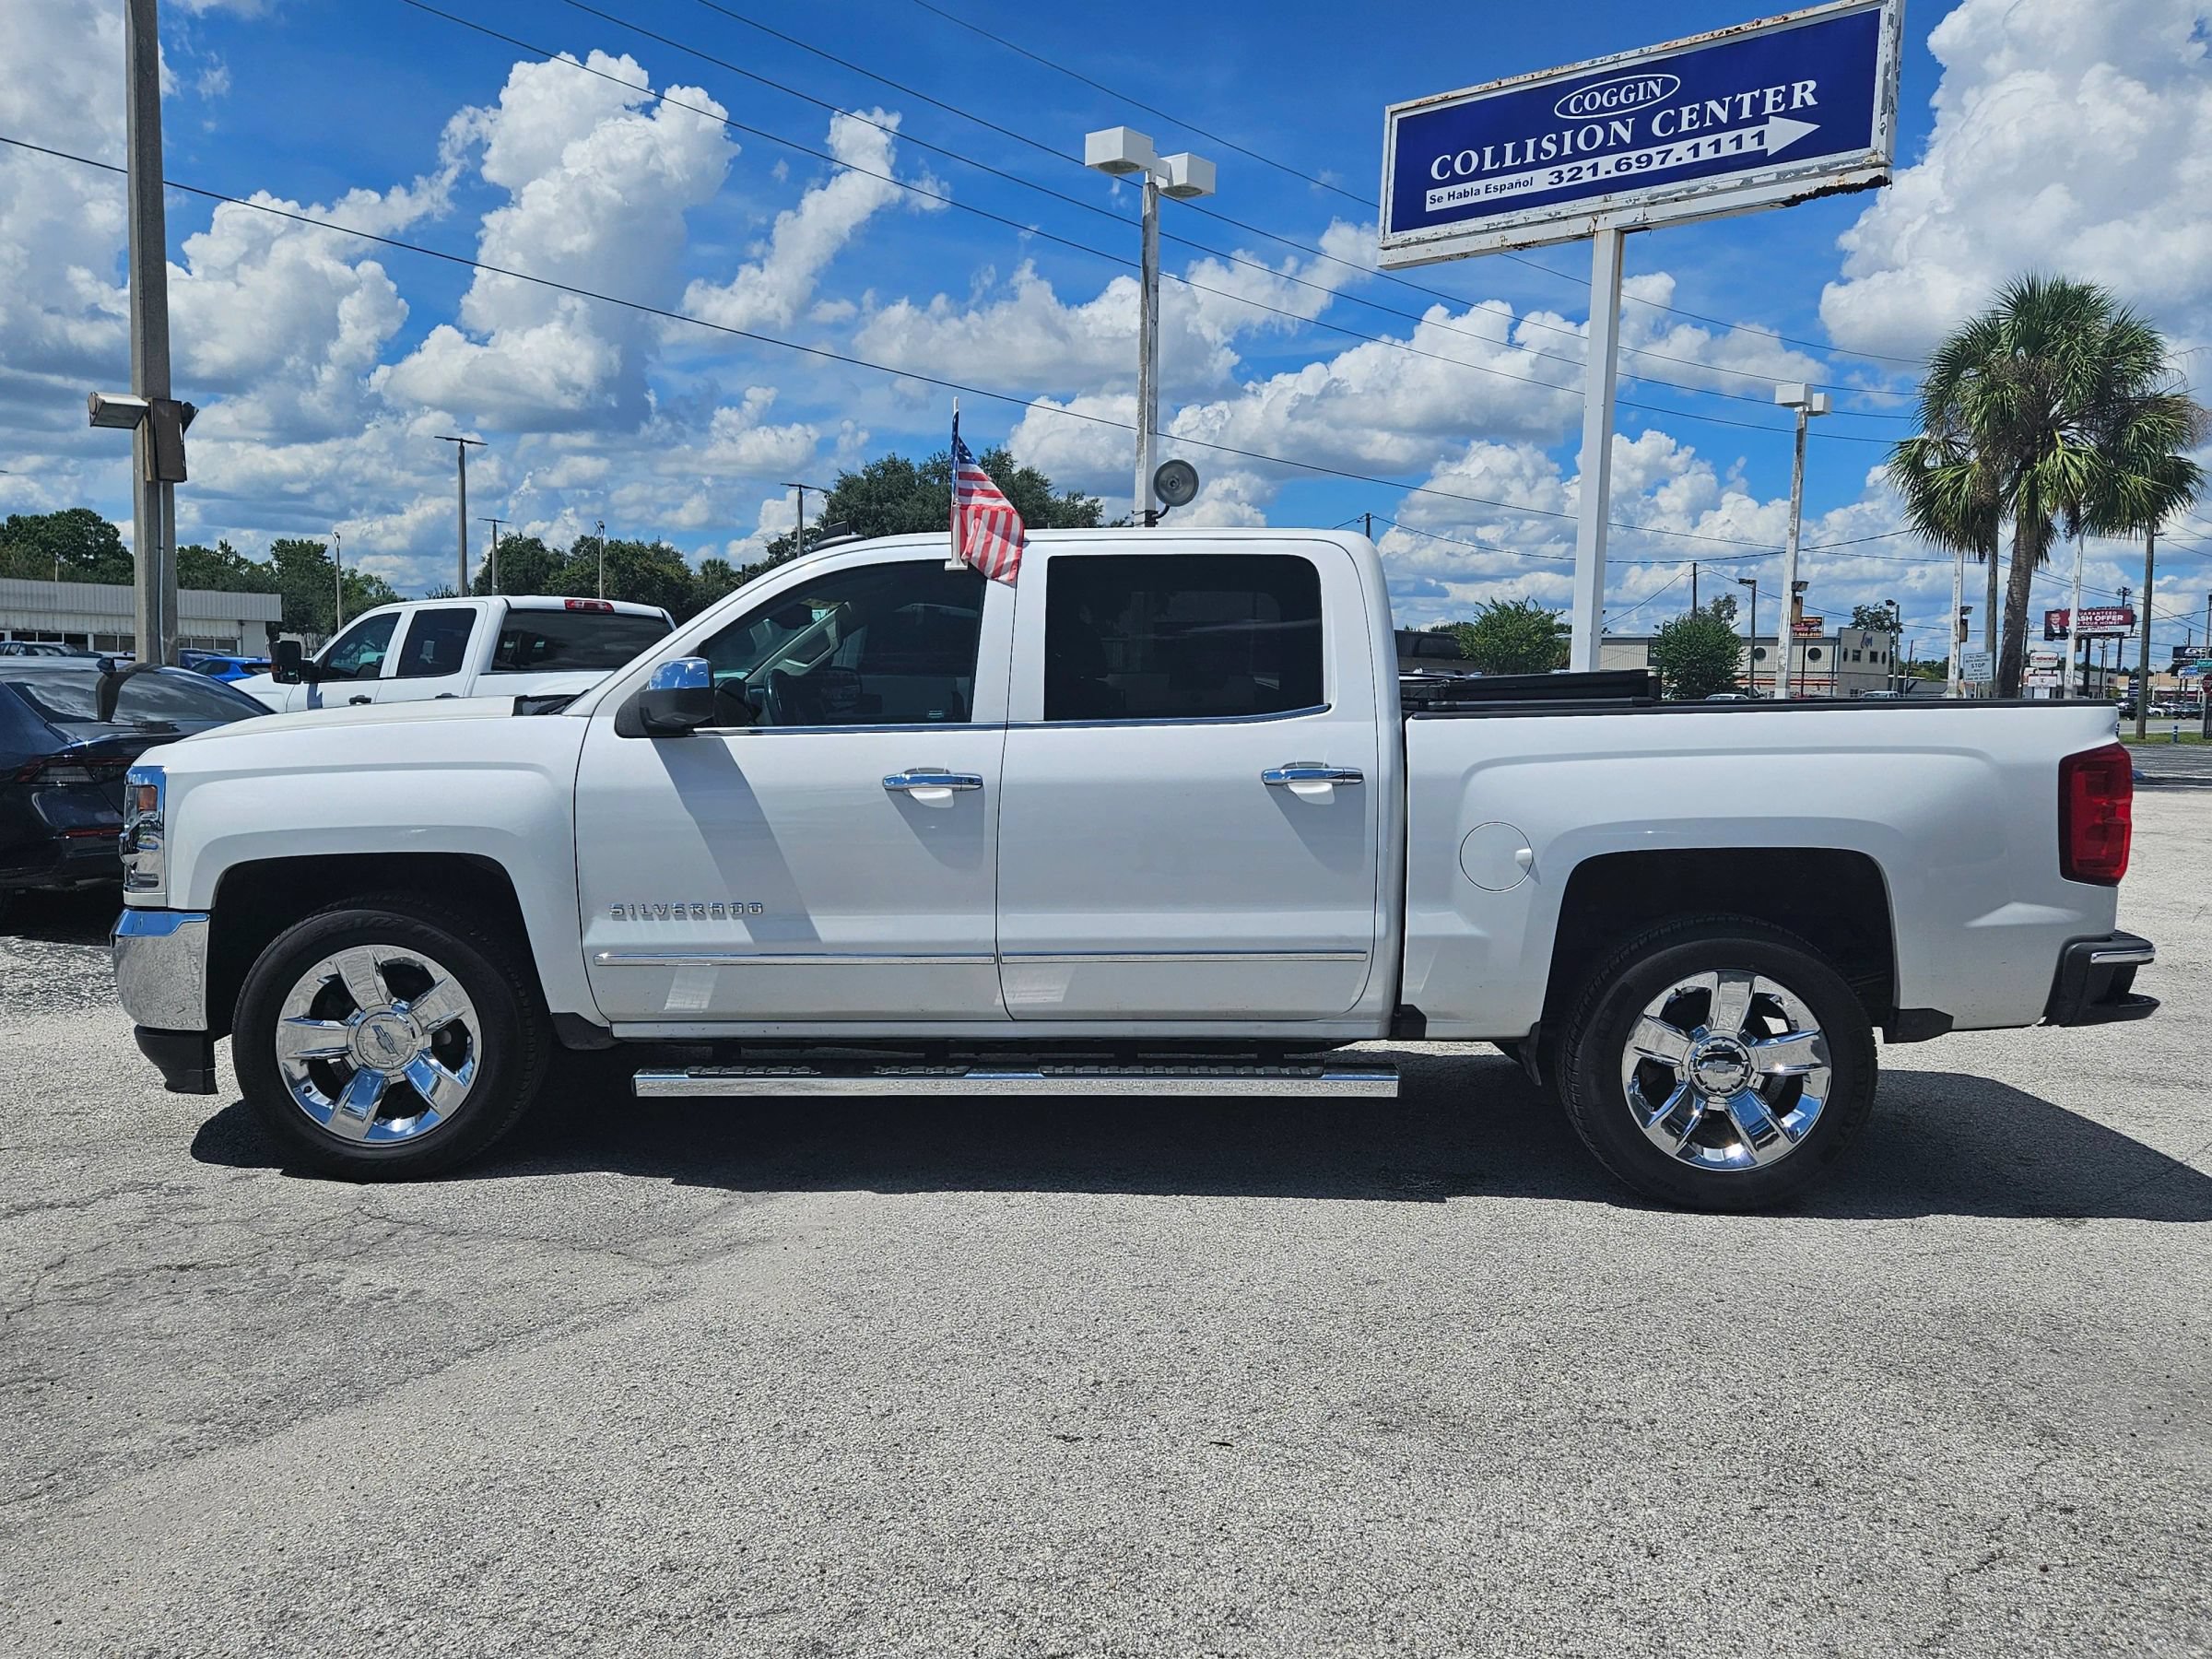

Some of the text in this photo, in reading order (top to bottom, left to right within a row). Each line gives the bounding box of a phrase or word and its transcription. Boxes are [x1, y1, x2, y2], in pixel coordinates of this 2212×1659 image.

[1569, 78, 1664, 114] COGGIN
[1430, 79, 1818, 180] COLLISION CENTER
[1429, 129, 1765, 205] Se Habla Español 321.697.1111
[609, 902, 764, 916] SILVERADO
